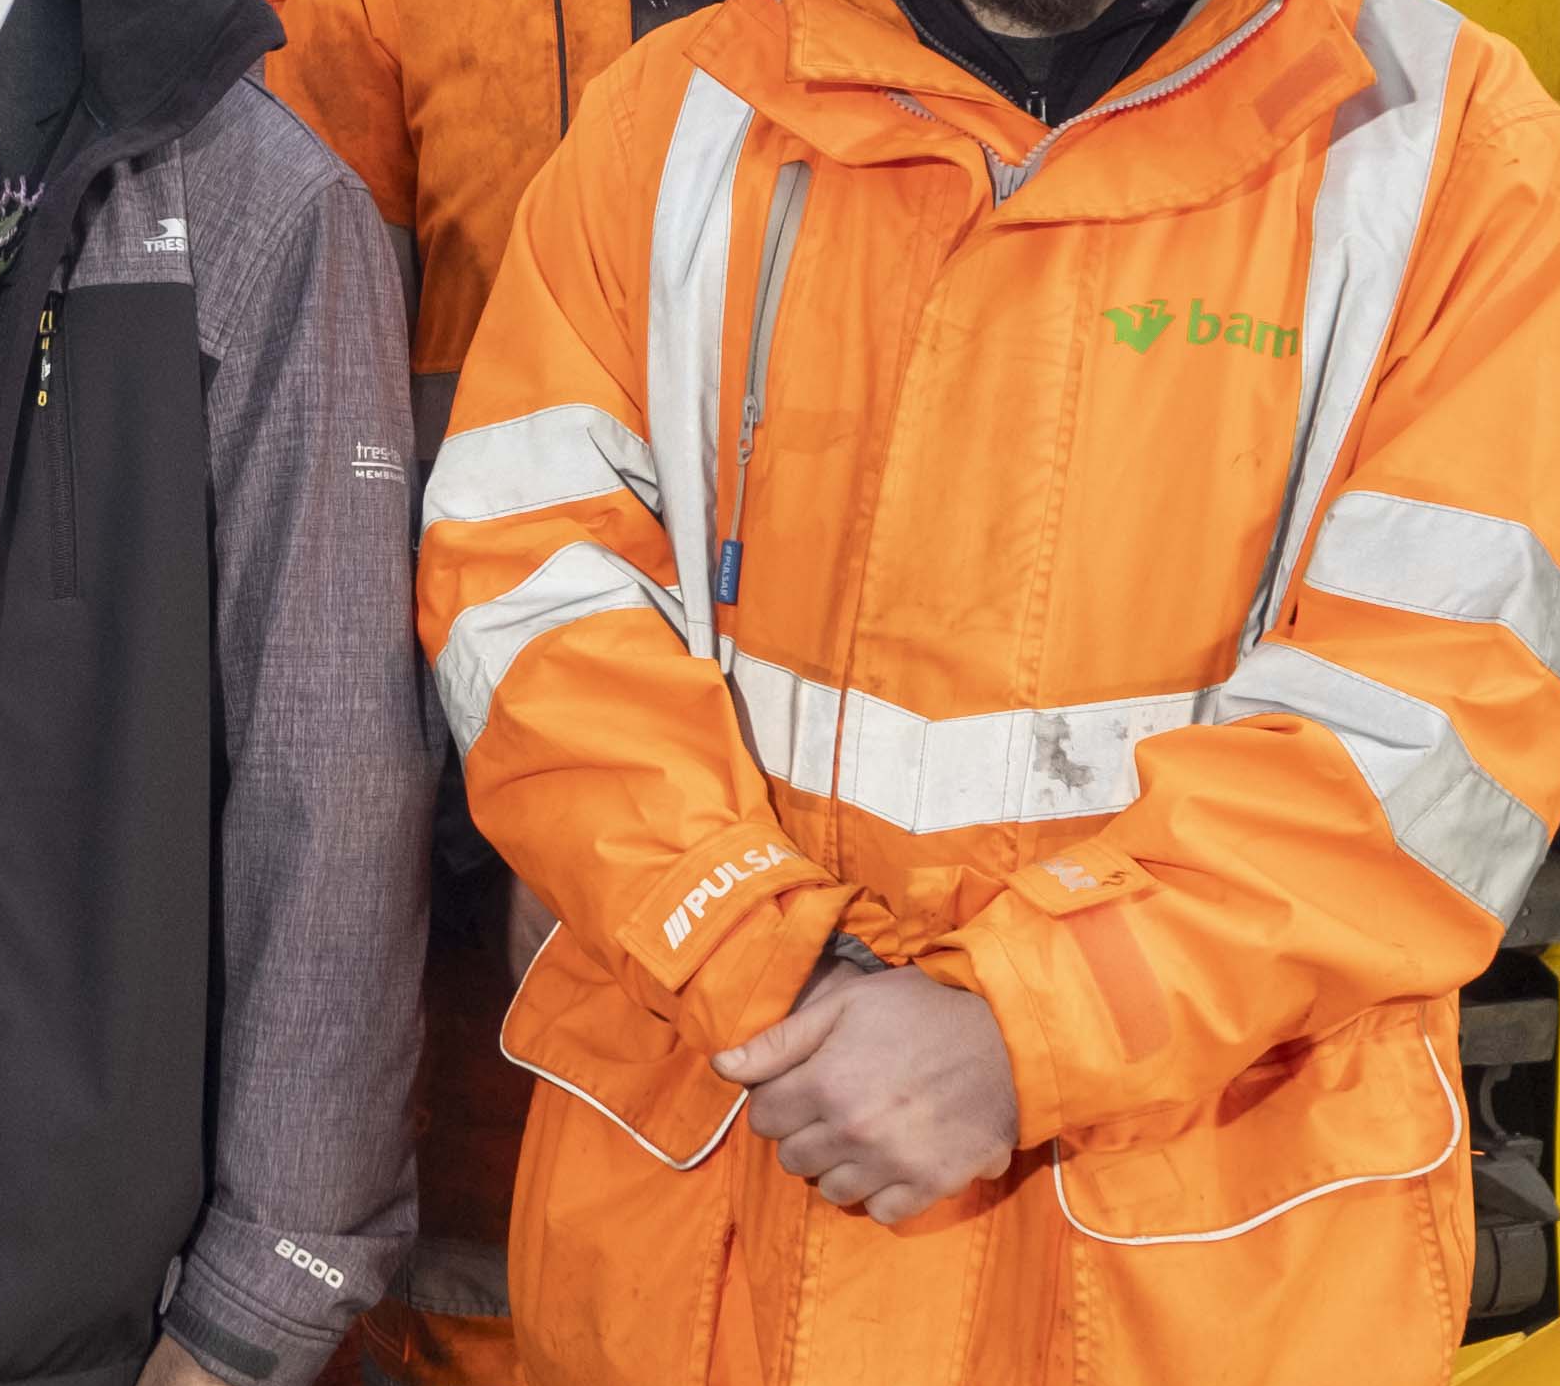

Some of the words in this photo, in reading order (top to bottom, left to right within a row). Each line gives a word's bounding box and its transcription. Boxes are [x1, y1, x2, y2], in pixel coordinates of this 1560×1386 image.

[143, 238, 185, 253] TRES
[1187, 298, 1299, 359] bam
[683, 843, 794, 919] PULSA
[274, 1238, 345, 1289] 8000
